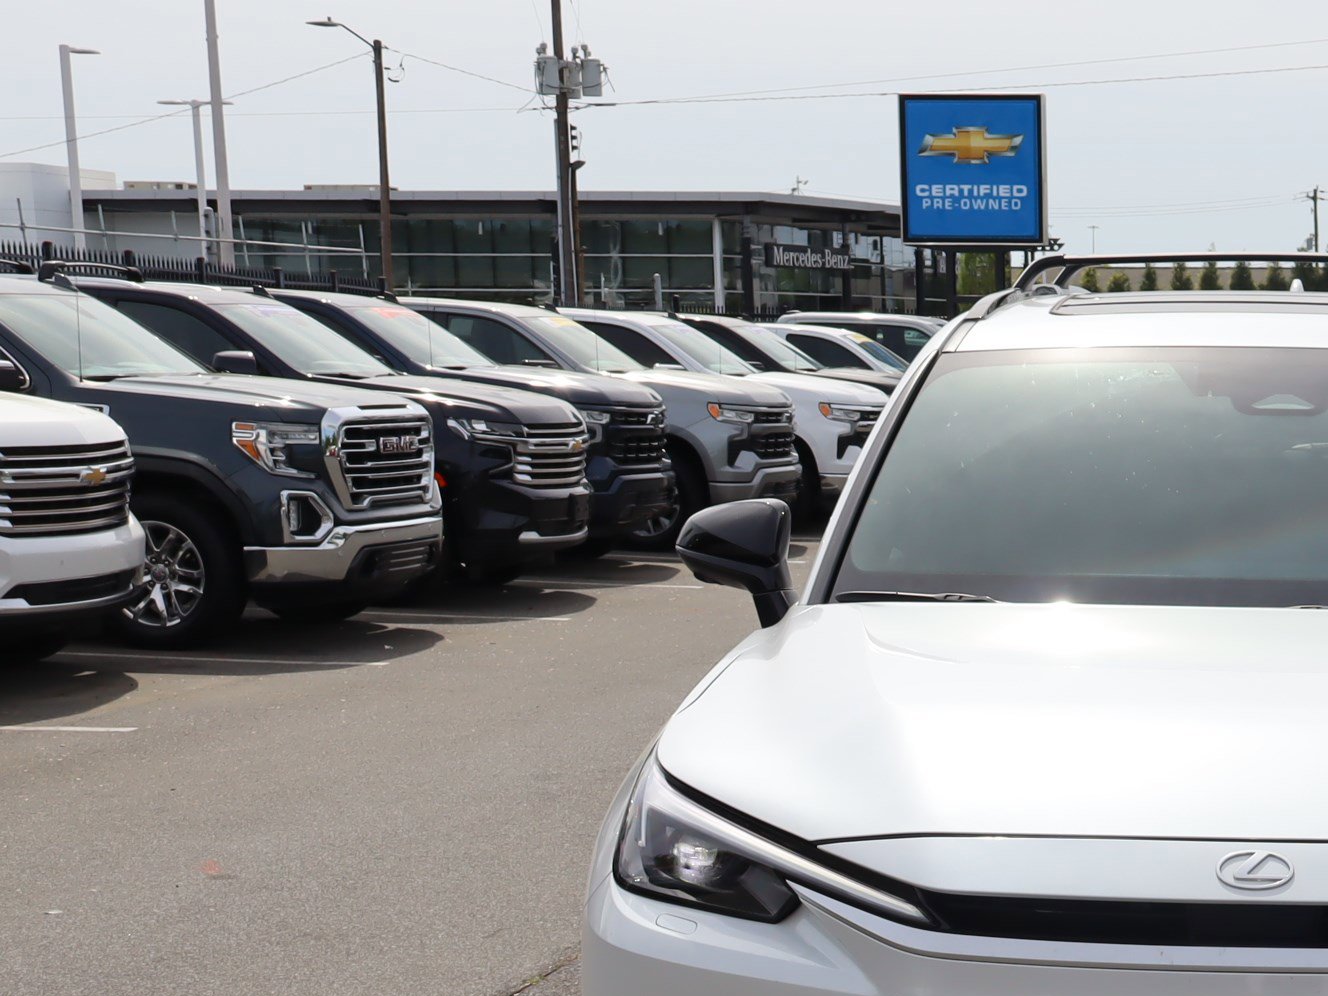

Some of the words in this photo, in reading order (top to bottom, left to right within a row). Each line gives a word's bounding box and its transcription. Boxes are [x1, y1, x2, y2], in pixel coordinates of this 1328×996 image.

[915, 184, 1027, 197] CERTIFIED
[922, 199, 1021, 210] PRE-OWNED
[773, 245, 849, 268] Mercedes-Benz
[380, 435, 418, 453] GMC
